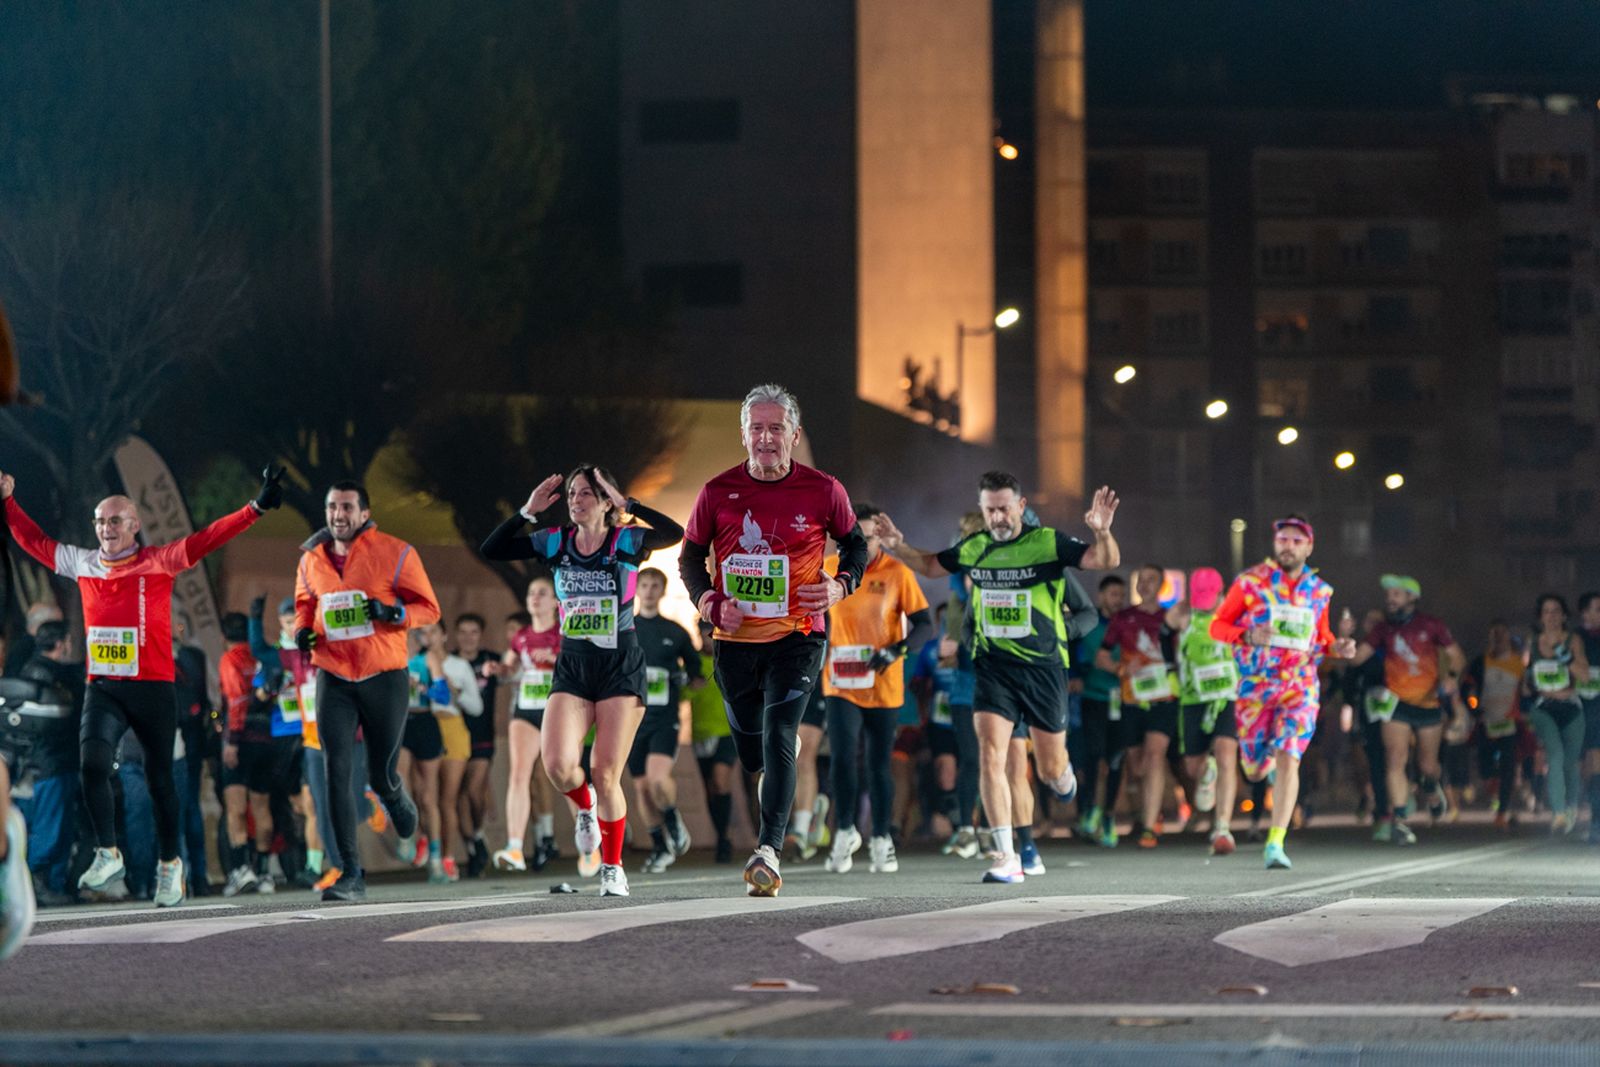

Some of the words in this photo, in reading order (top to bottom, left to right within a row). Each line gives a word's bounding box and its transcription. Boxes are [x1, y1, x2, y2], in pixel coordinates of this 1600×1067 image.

[970, 568, 993, 580] CAJA
[997, 568, 1036, 580] RURAL
[736, 576, 774, 596] 2279
[334, 608, 356, 624] 897
[569, 614, 608, 630] 12381
[990, 608, 1020, 622] 1433
[97, 645, 128, 660] 2768
